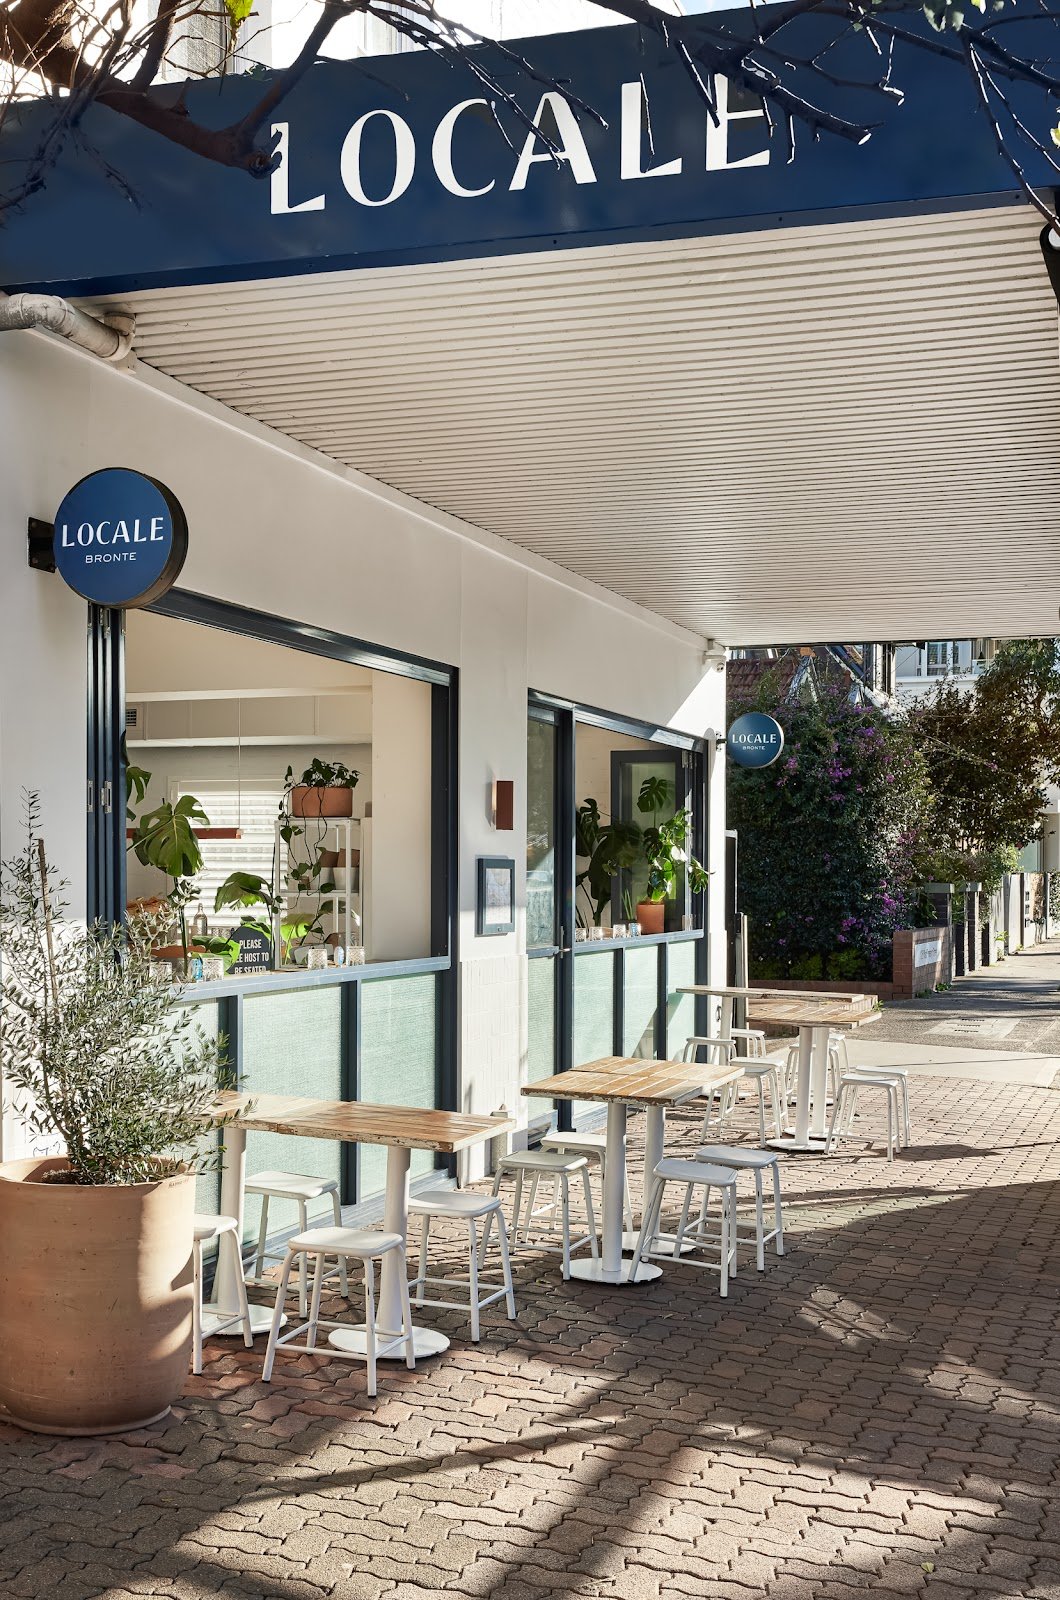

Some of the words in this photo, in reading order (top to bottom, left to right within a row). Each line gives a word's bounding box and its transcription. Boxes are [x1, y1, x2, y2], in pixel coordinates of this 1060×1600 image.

[269, 72, 771, 215] LOCALE
[61, 516, 164, 547] LOCALE
[85, 552, 137, 564] BRONTE
[732, 733, 777, 744] LOCALE
[239, 939, 262, 949] PLEASE
[244, 952, 260, 963] HOST
[261, 952, 270, 962] TO
